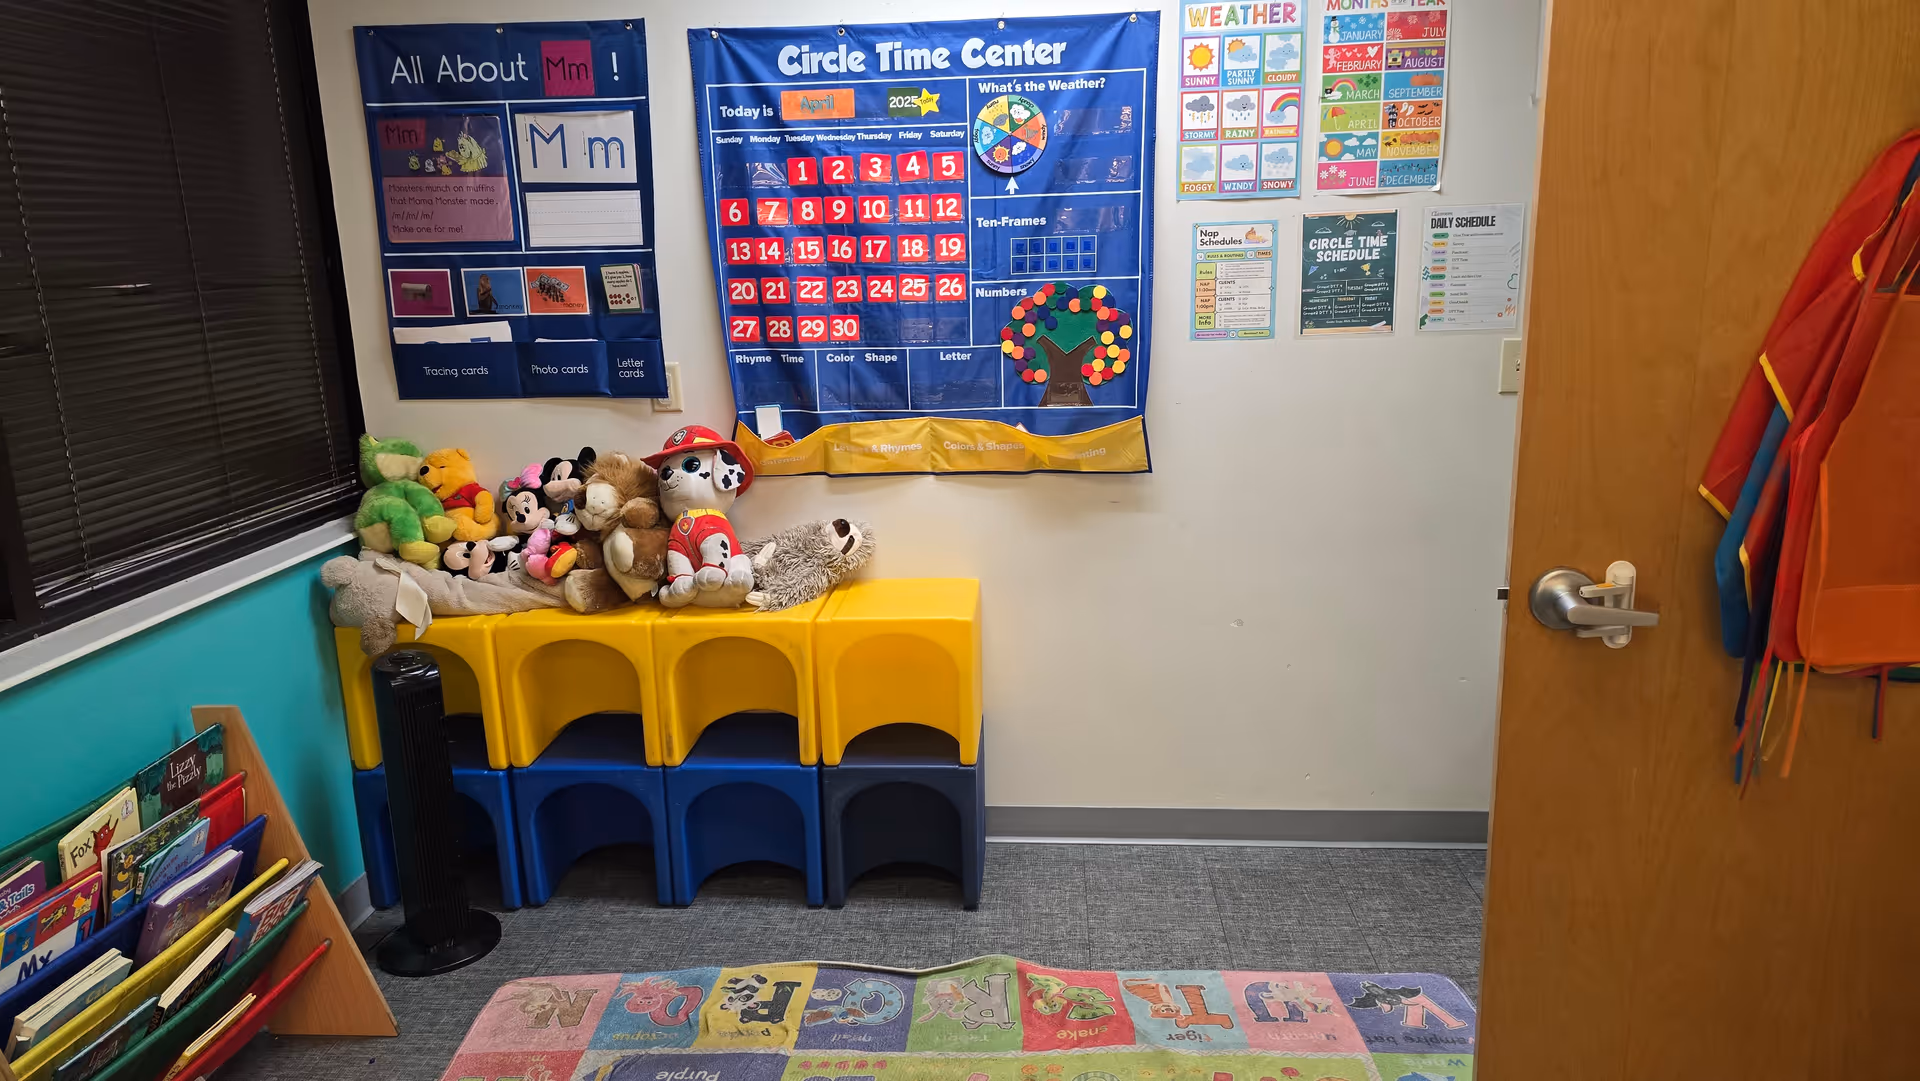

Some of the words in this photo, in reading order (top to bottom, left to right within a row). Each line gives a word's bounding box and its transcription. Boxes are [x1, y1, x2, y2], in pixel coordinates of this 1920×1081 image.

[1188, 2, 1298, 28] WEATHER
[1340, 29, 1384, 41] JANUARY
[1422, 26, 1446, 38] JULY
[778, 44, 866, 76] Circle
[875, 40, 951, 72] Time
[960, 37, 1068, 69] Center
[1404, 56, 1444, 68] AUGUST
[390, 54, 424, 84] All
[436, 52, 529, 84] About
[546, 56, 590, 81] Mm
[1336, 60, 1382, 72] FEBRUARY
[1226, 69, 1256, 79] PARTLY
[1267, 73, 1296, 82] CLOUDY
[978, 78, 1022, 94] What's
[1024, 80, 1046, 92] the
[1048, 77, 1106, 91] Weather?
[1184, 76, 1216, 86] SUNNY
[1227, 77, 1255, 86] SUNNY
[1346, 89, 1380, 100] MARCH
[1388, 86, 1443, 99] SEPTEMBER
[720, 105, 760, 119] Today
[762, 104, 774, 117] is
[800, 94, 834, 114] April
[889, 95, 919, 108] 2025
[1348, 118, 1378, 129] APRIL
[1397, 116, 1441, 128] OCTOBER
[385, 126, 419, 145] Mm
[716, 136, 743, 145] Sunday
[750, 134, 782, 145] Monday
[784, 134, 815, 144] Tuesday
[816, 133, 856, 142] Wednesday
[856, 132, 892, 142] Thursday
[898, 131, 923, 140] Friday
[930, 130, 965, 140] Saturday
[1184, 131, 1216, 139] STORMY
[1225, 130, 1255, 138] RAINY
[528, 123, 568, 169] M
[587, 136, 626, 169] m
[1386, 146, 1439, 158] NOVEMBER
[1356, 147, 1377, 158] MAY
[798, 161, 807, 181] 1
[832, 160, 845, 179] 2
[869, 157, 882, 177] 3
[906, 155, 920, 175] 4
[942, 156, 956, 176] 5
[1262, 180, 1294, 190] SNOWY
[1348, 176, 1375, 187] JUNE
[1386, 174, 1437, 185] DECEMBER
[388, 184, 423, 192] Monsters
[466, 184, 496, 192] muffins
[1184, 183, 1214, 192] FOGGY
[1224, 182, 1254, 191] WINDY
[435, 197, 467, 205] Monster
[729, 202, 741, 222] 6
[765, 202, 781, 222] 7
[802, 201, 814, 220] 8
[833, 200, 845, 220] 9
[863, 200, 887, 218] 10
[903, 199, 925, 219] 11
[936, 198, 960, 216] 12
[976, 216, 1047, 228] Ten-Frames
[1430, 217, 1454, 229] DAILY
[1455, 215, 1496, 228] SCHEDULE
[434, 224, 445, 233] for
[1200, 228, 1220, 239] Nap
[1199, 236, 1242, 246] Schedules
[1308, 236, 1354, 250] CIRCLE
[1358, 235, 1388, 248] TIME
[731, 243, 750, 260] 13
[759, 242, 780, 260] 14
[798, 241, 819, 259] 15
[832, 240, 852, 258] 16
[866, 240, 887, 258] 17
[902, 239, 925, 257] 18
[940, 238, 962, 256] 19
[1316, 248, 1381, 262] SCHEDULE
[731, 282, 754, 299] 20
[766, 282, 786, 299] 21
[799, 281, 824, 298] 22
[836, 280, 858, 298] 23
[870, 280, 893, 297] 24
[902, 278, 926, 296] 25
[939, 278, 962, 296] 26
[975, 287, 1028, 298] Numbers
[733, 320, 756, 337] 27
[769, 321, 790, 337] 28
[801, 320, 824, 338] 29
[833, 319, 856, 336] 30
[735, 354, 772, 364] Rhyme
[781, 354, 804, 364] Time
[826, 353, 855, 363] Color
[864, 353, 898, 364] Shape
[939, 351, 972, 361] Letter
[531, 364, 558, 374] Photo
[561, 364, 589, 374] cards
[616, 358, 645, 368] Letter
[422, 366, 458, 378] Tracing
[461, 366, 489, 376] cards
[618, 368, 645, 378] cards
[880, 442, 923, 454] Rhymes
[944, 440, 976, 451] Colors
[976, 442, 985, 451] &
[986, 442, 1025, 452] Shapes
[170, 754, 196, 779] Lizzy
[8, 884, 35, 907] Tails
[1056, 1024, 1109, 1041] snake
[1166, 1030, 1213, 1043] tiger
[655, 1068, 721, 1081] Purple
